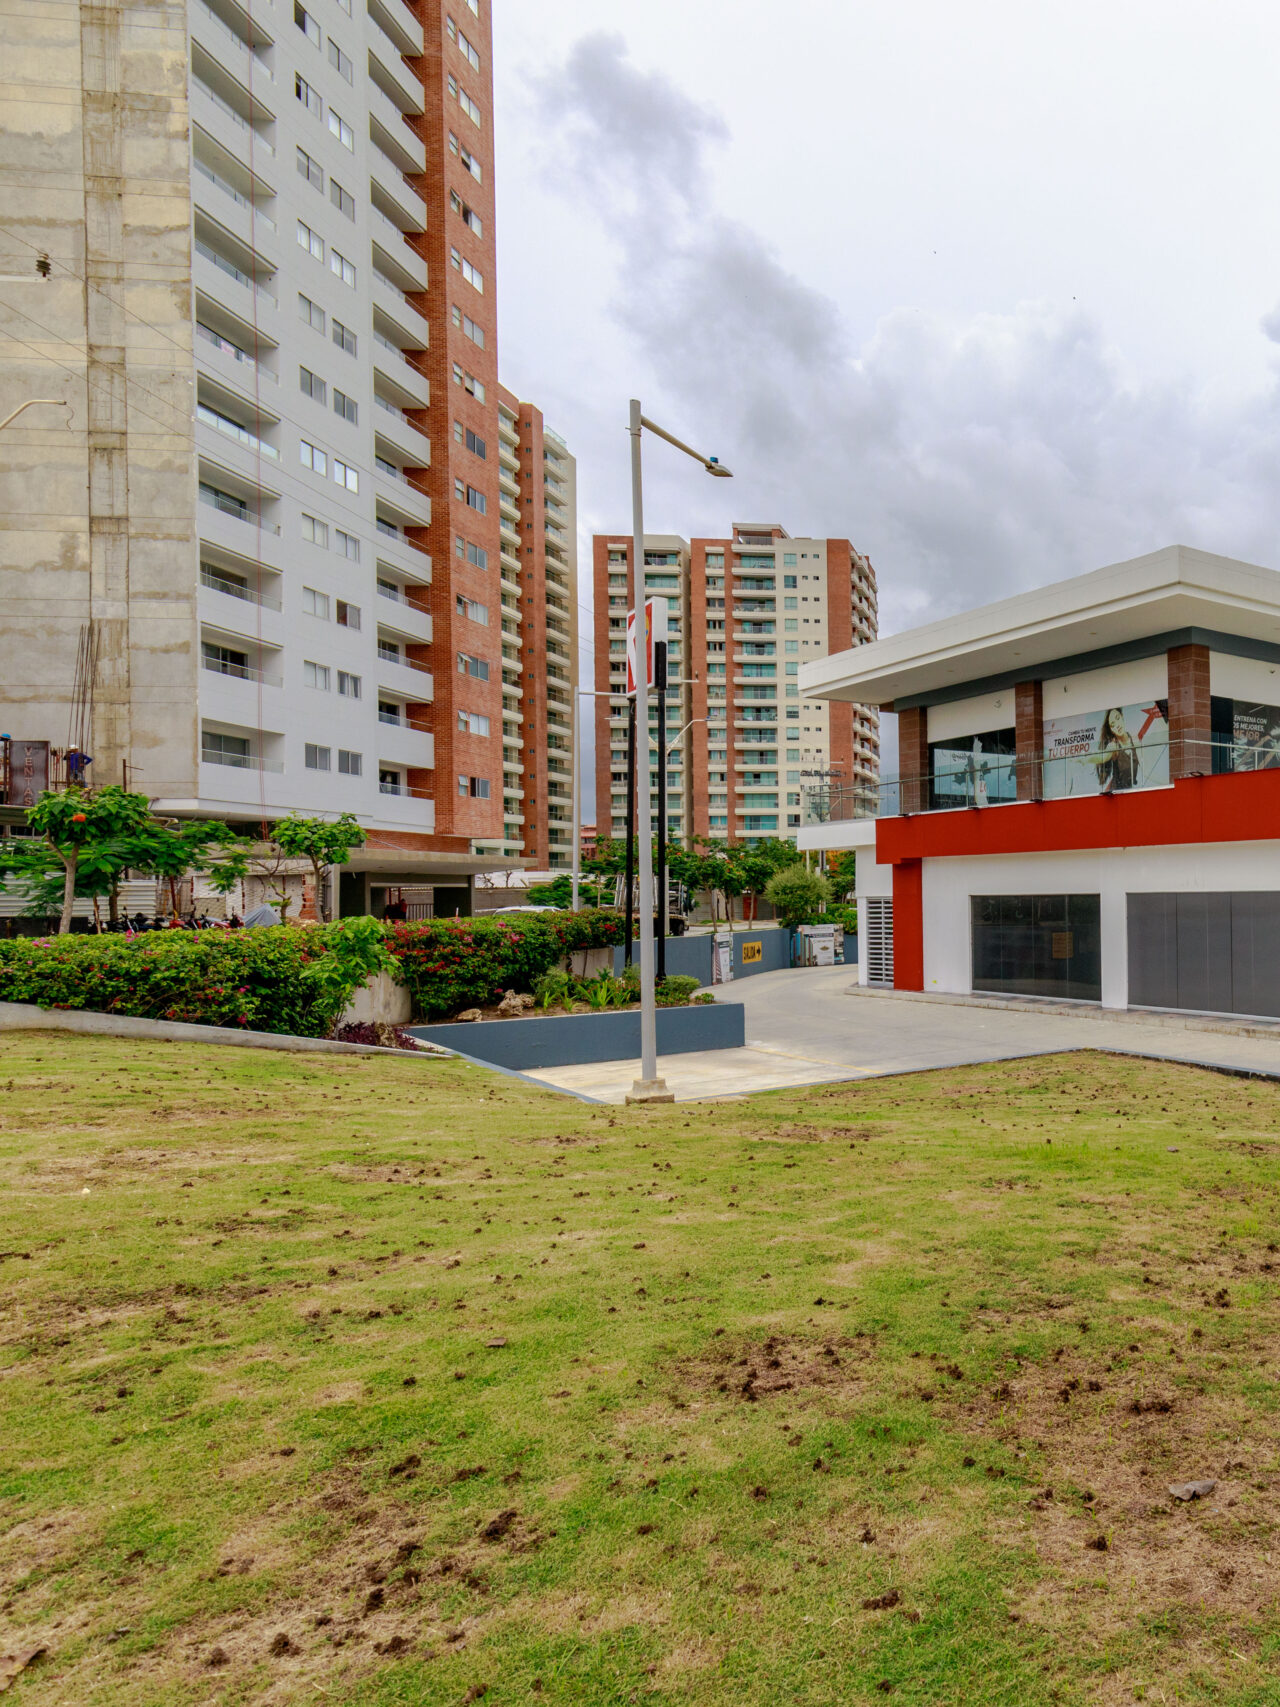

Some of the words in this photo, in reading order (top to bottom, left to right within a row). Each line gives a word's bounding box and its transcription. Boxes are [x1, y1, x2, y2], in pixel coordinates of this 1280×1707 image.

[1054, 733, 1095, 747] TRANSFORMA
[1049, 747, 1059, 759] TU
[1059, 743, 1090, 757] CUERPO
[24, 745, 34, 806] VENTAS
